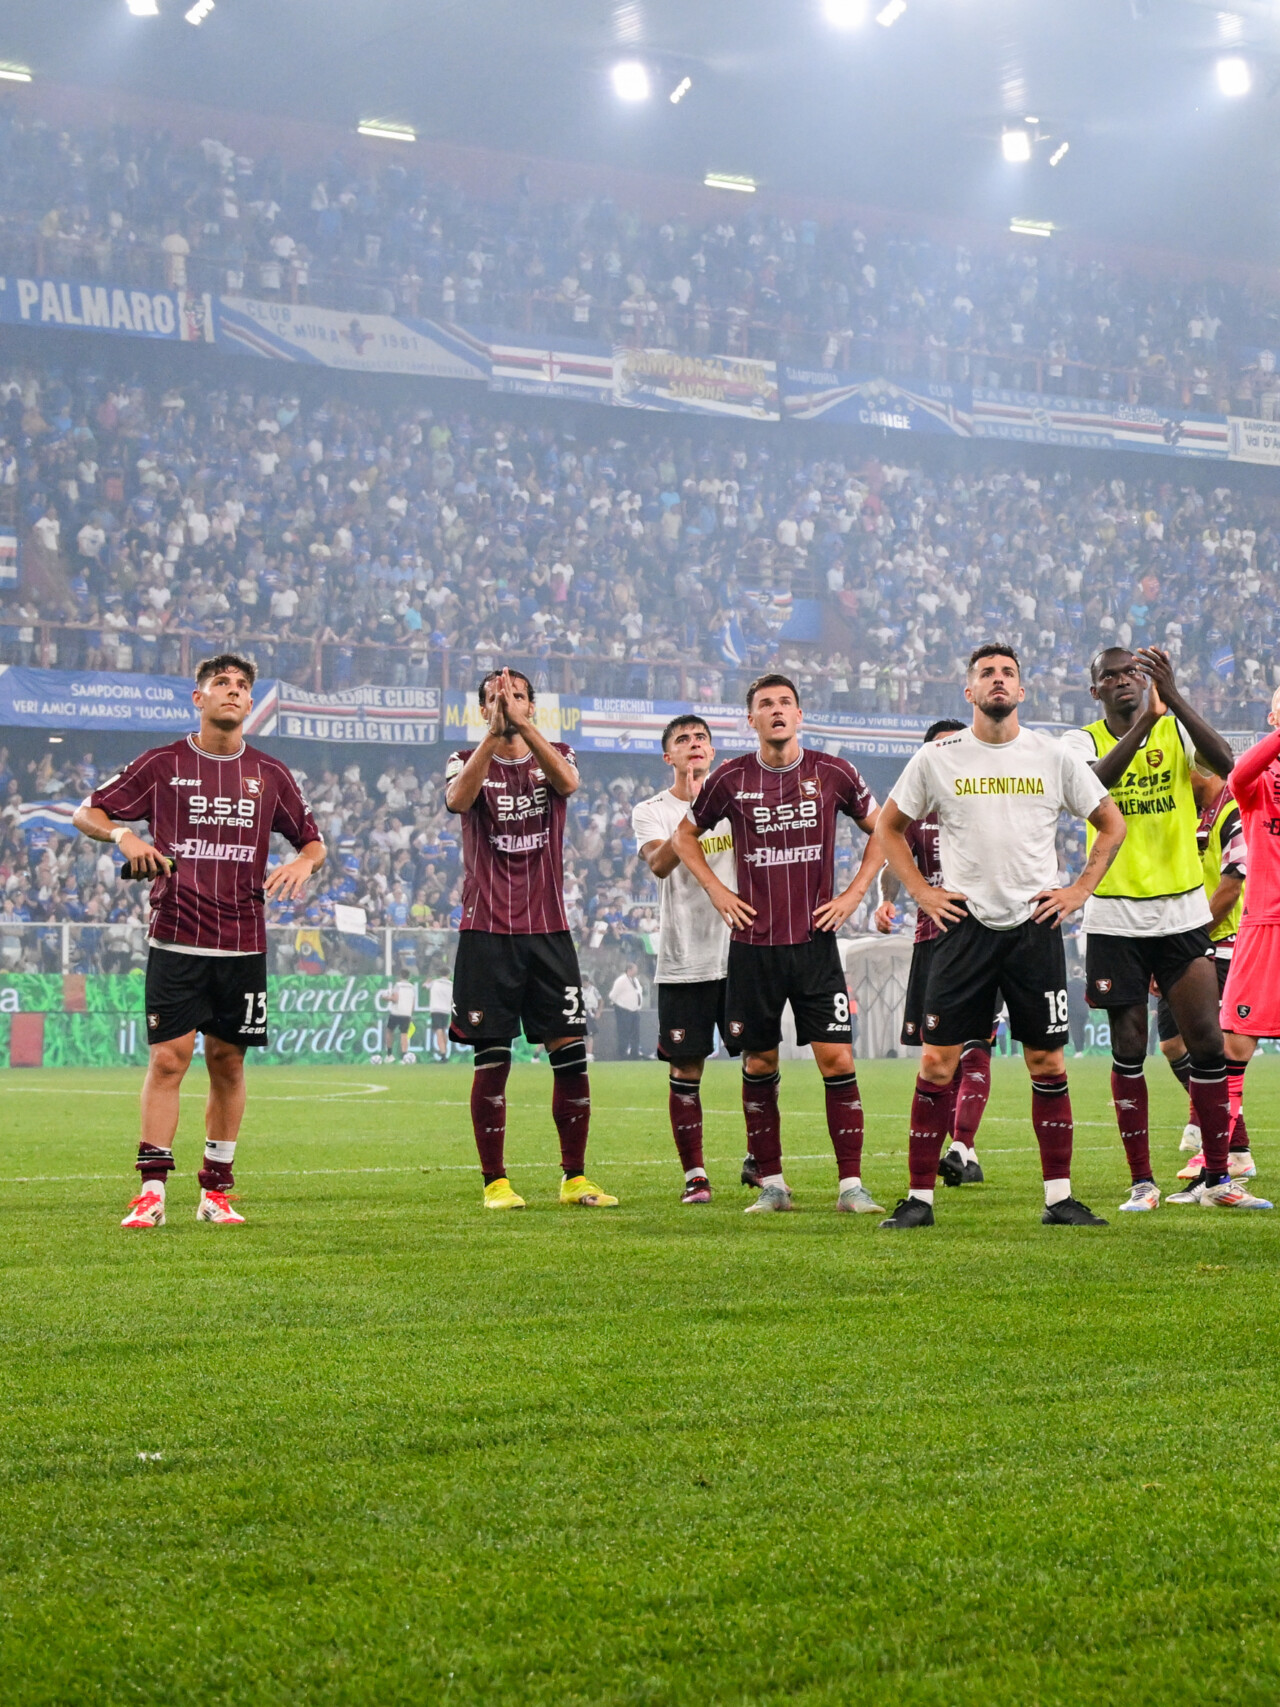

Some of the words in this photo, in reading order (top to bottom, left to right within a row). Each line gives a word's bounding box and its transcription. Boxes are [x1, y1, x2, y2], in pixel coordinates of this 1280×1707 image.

[17, 279, 175, 334] PALMARO
[246, 302, 292, 323] CLUB
[786, 366, 839, 386] SAMPDORIA
[668, 381, 726, 402] SAVONA
[928, 384, 954, 399] CLUB
[972, 388, 1109, 412] CARLOFORTE
[1247, 434, 1261, 447] Val
[70, 683, 142, 699] SAMPDORIA
[145, 685, 174, 701] CLUB
[385, 688, 437, 708] CLUBS
[13, 700, 37, 715] VERI
[42, 702, 76, 716] AMICI
[80, 704, 131, 718] MARASSI
[593, 698, 654, 714] BLUCERCHIATI
[286, 718, 436, 743] BLUCERCHIATI
[839, 714, 866, 726] BELLO
[869, 717, 898, 727] VIVERE
[902, 719, 918, 728] UNA
[169, 777, 203, 787] Zeus
[482, 778, 508, 789] Zeus
[955, 777, 1045, 796] SALERNITANA
[1126, 770, 1171, 789] Zeus
[735, 791, 765, 800] Zeus
[189, 816, 254, 828] SANTERO
[756, 818, 817, 834] SANTERO
[279, 976, 369, 1013] verde
[562, 986, 586, 1018] 3
[244, 992, 267, 1025] 13
[834, 992, 849, 1023] 8
[1044, 989, 1068, 1024] 18
[120, 1019, 135, 1055] il
[238, 1025, 266, 1035] Zeus
[258, 1014, 356, 1054] verde
